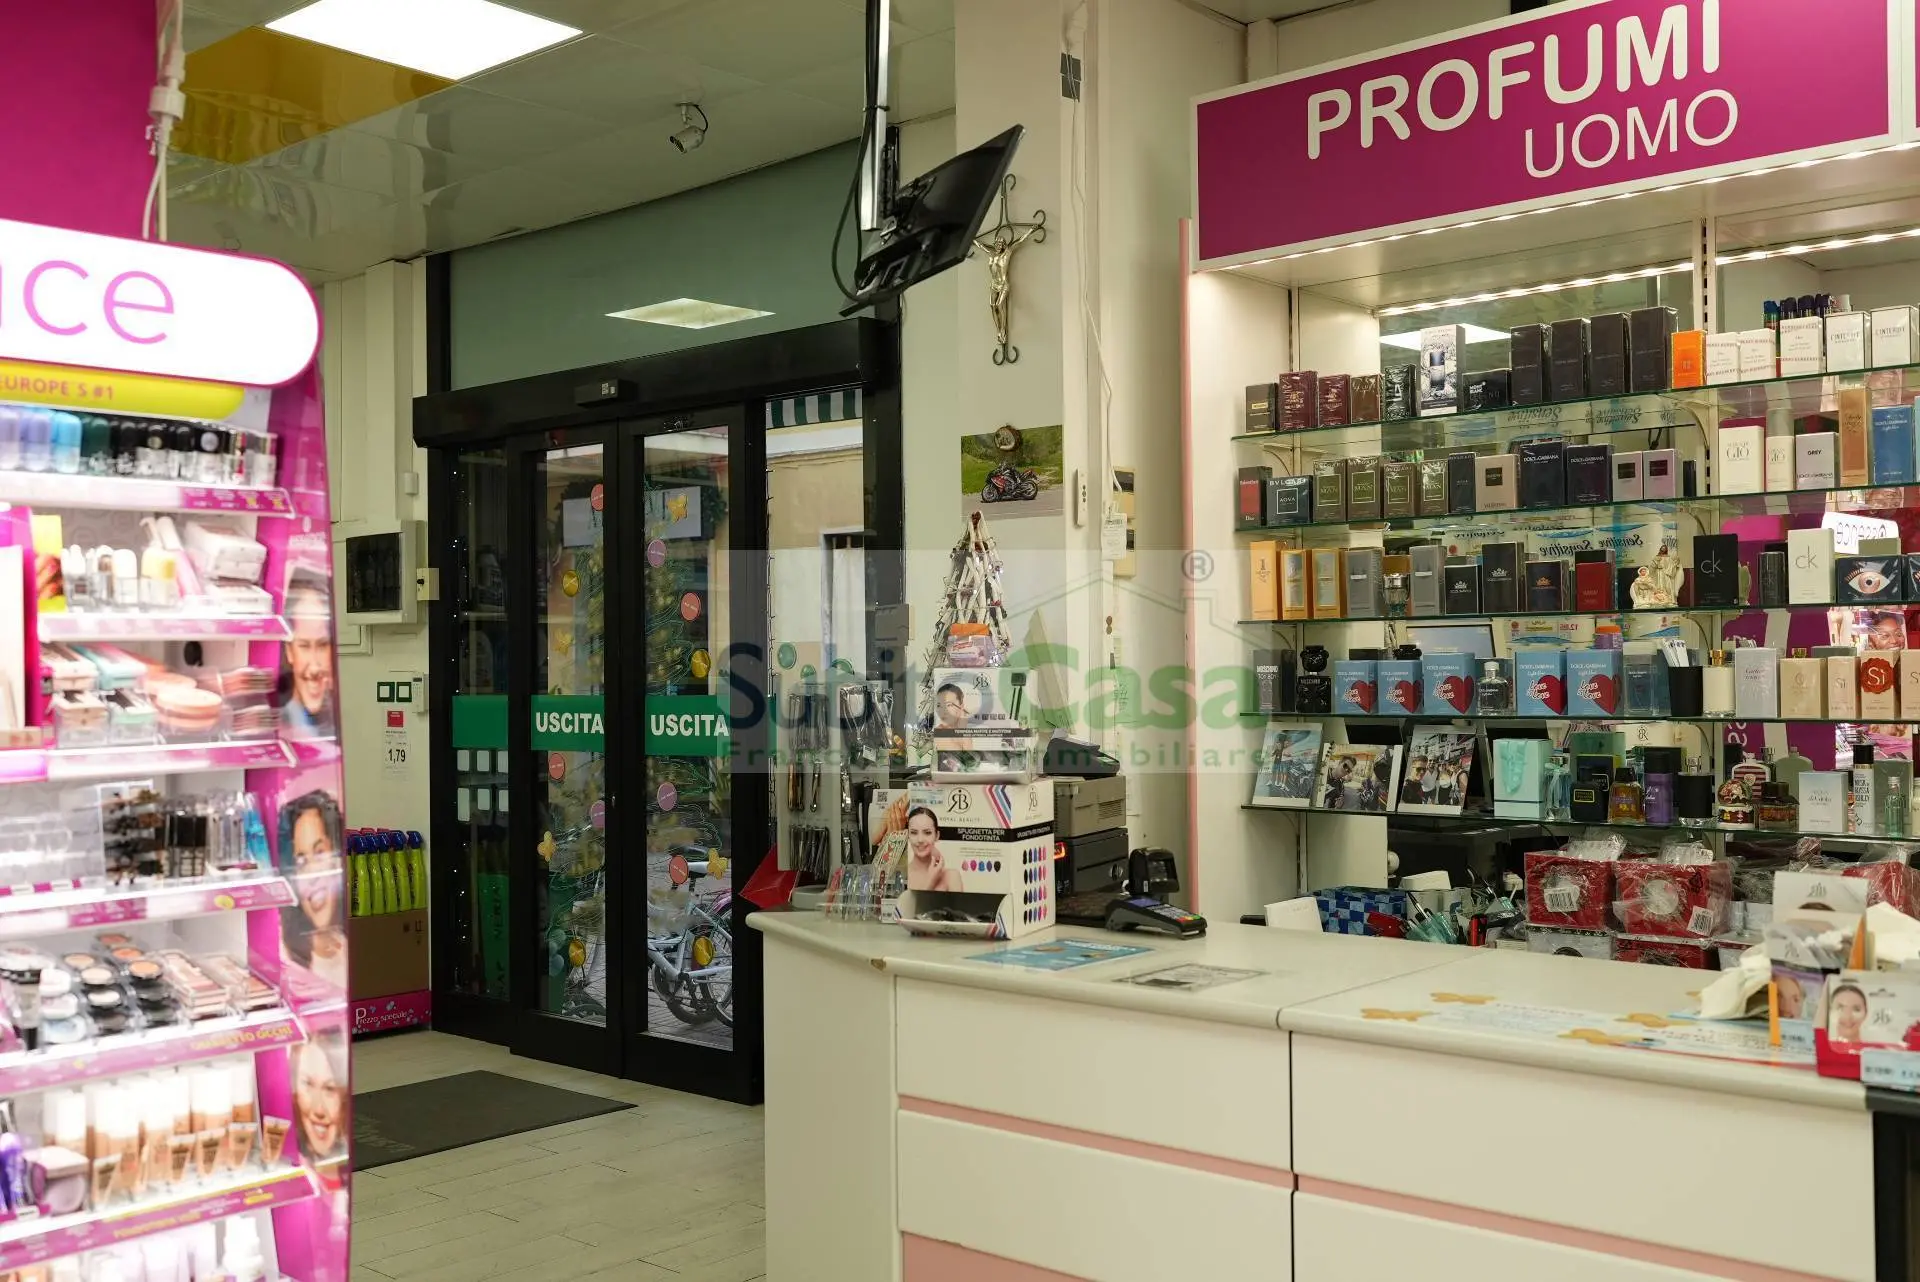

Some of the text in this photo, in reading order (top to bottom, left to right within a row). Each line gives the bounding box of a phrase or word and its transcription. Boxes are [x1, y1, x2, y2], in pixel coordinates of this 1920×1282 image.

[1307, 0, 1719, 160] PROFUMI
[1525, 88, 1738, 178] UOMO
[0, 259, 174, 345] ce
[536, 711, 604, 734] USCITA
[651, 714, 730, 737] USCITA
[388, 748, 406, 764] 1,79
